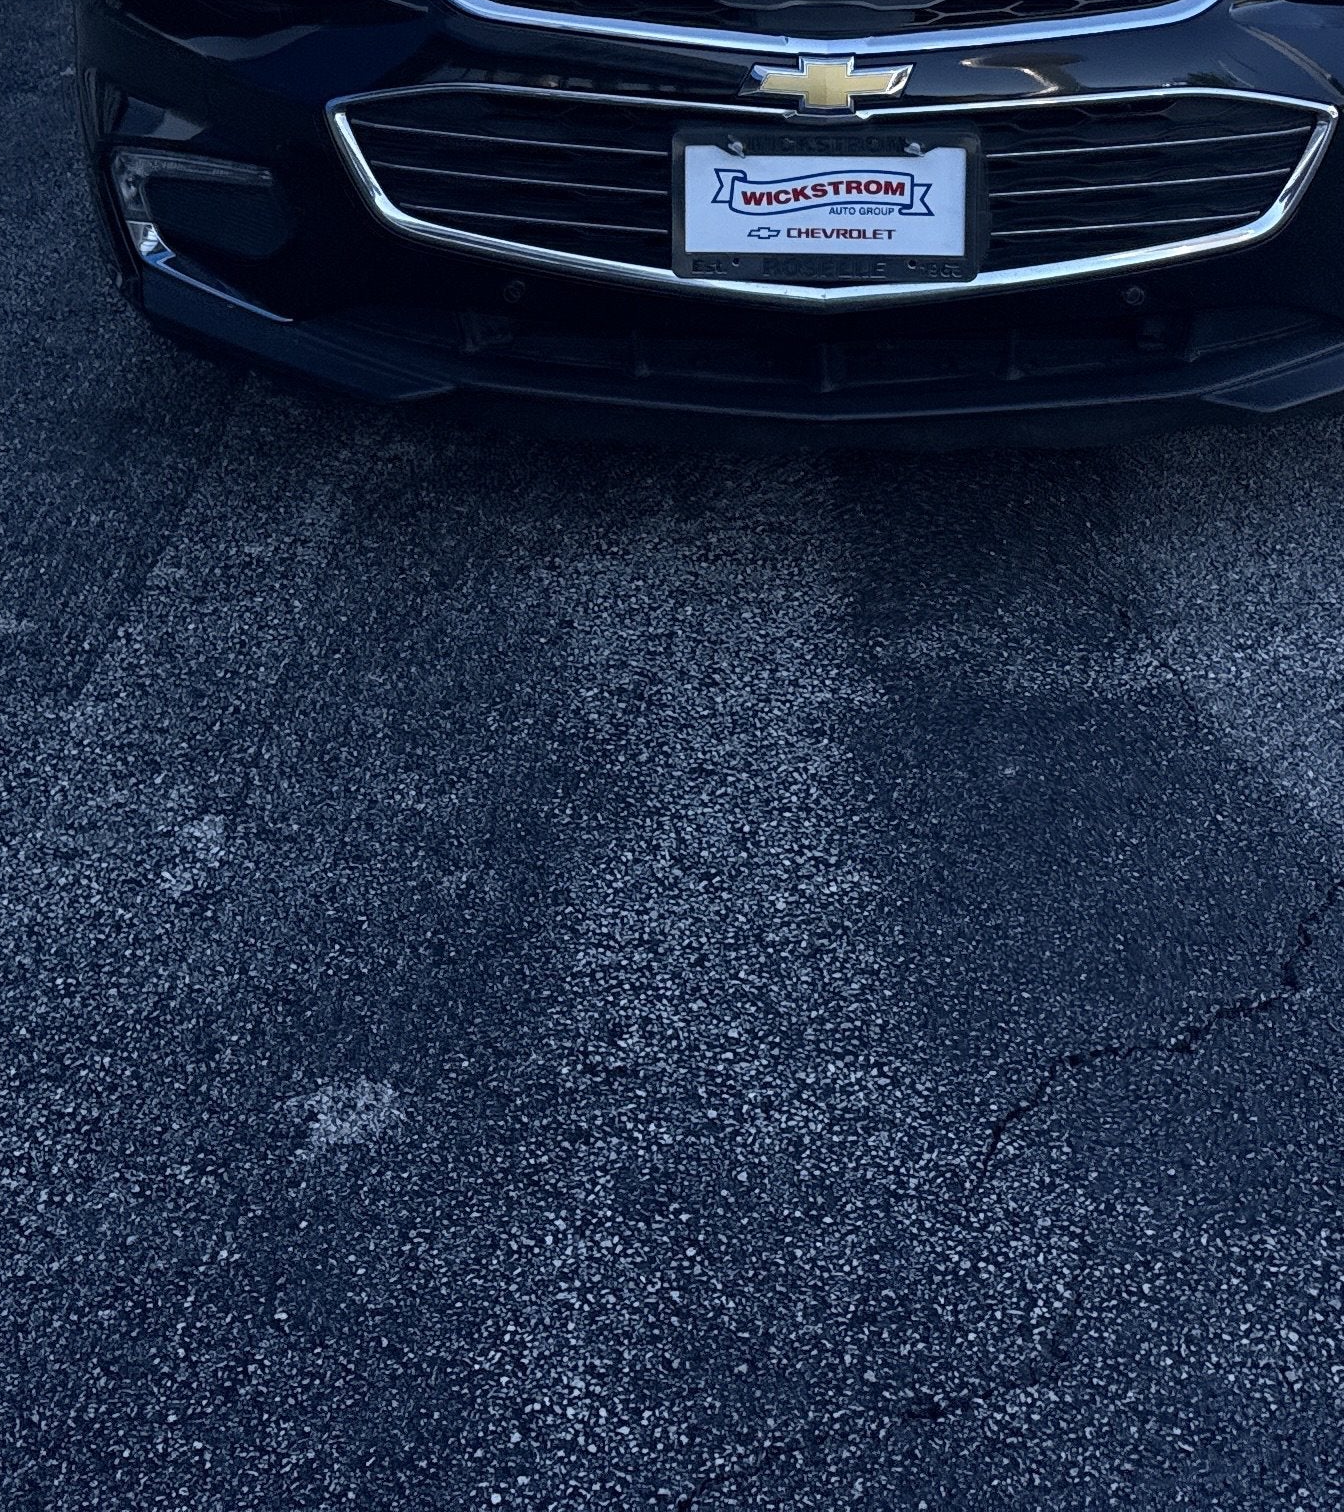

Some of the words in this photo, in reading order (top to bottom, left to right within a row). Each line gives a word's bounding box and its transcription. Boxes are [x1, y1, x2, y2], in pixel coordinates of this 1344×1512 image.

[740, 179, 906, 207] WICKSTROM
[828, 206, 857, 216] AUTO
[859, 206, 895, 216] GROUP
[786, 227, 896, 240] CHEVROLET
